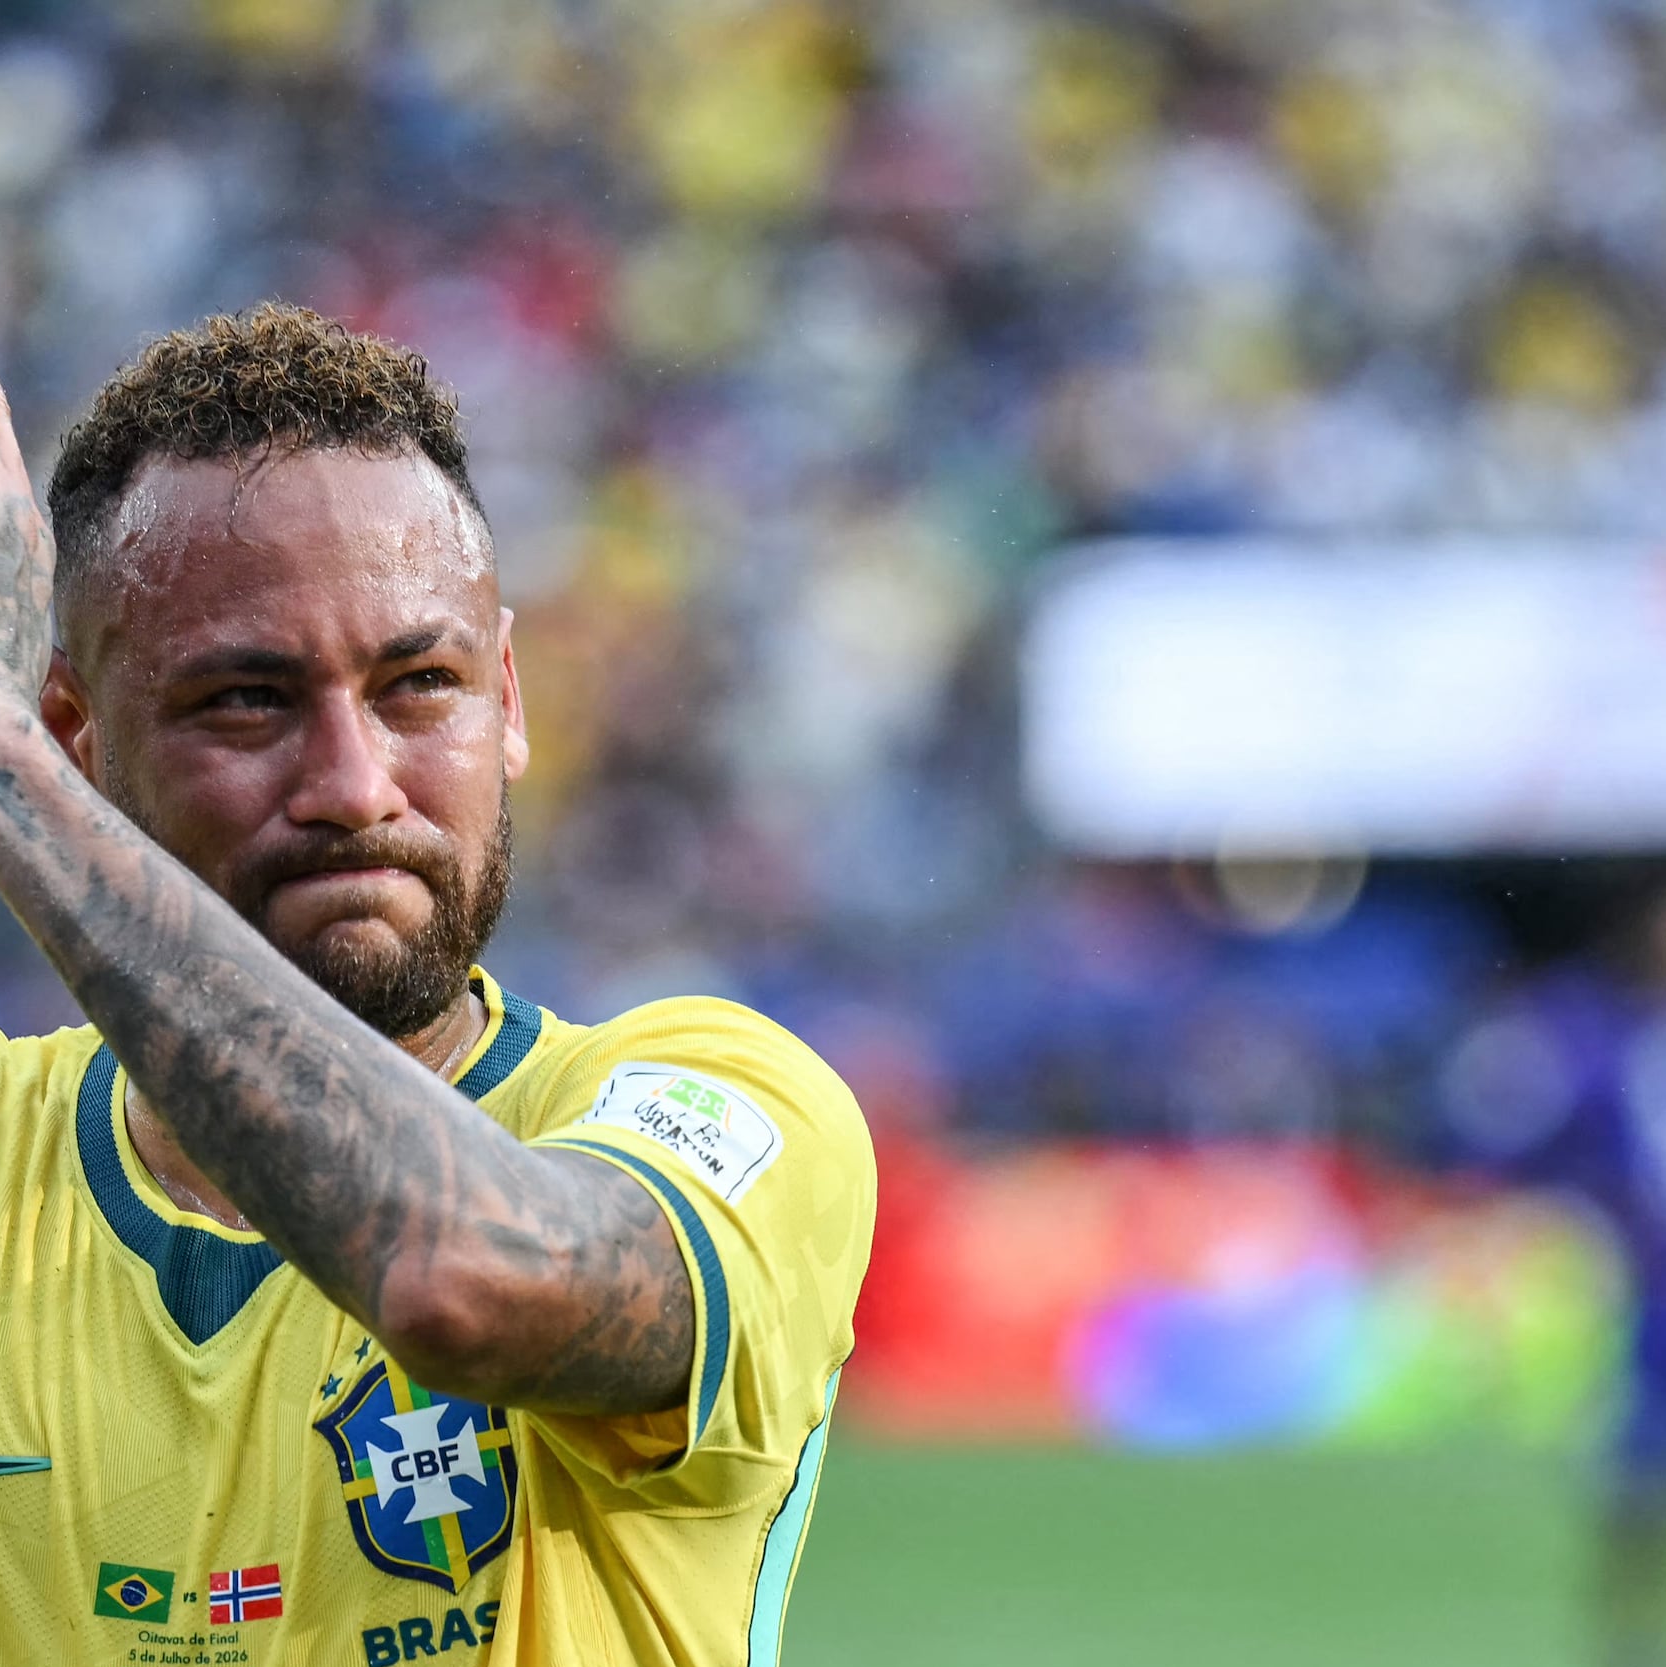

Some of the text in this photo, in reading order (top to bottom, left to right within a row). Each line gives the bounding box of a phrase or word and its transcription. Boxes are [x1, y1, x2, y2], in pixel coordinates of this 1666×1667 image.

[390, 1443, 459, 1483] CBF
[183, 1591, 197, 1603] vs
[138, 1630, 238, 1645] Oitavas de Final
[129, 1648, 248, 1665] 5 de Julho de 2026
